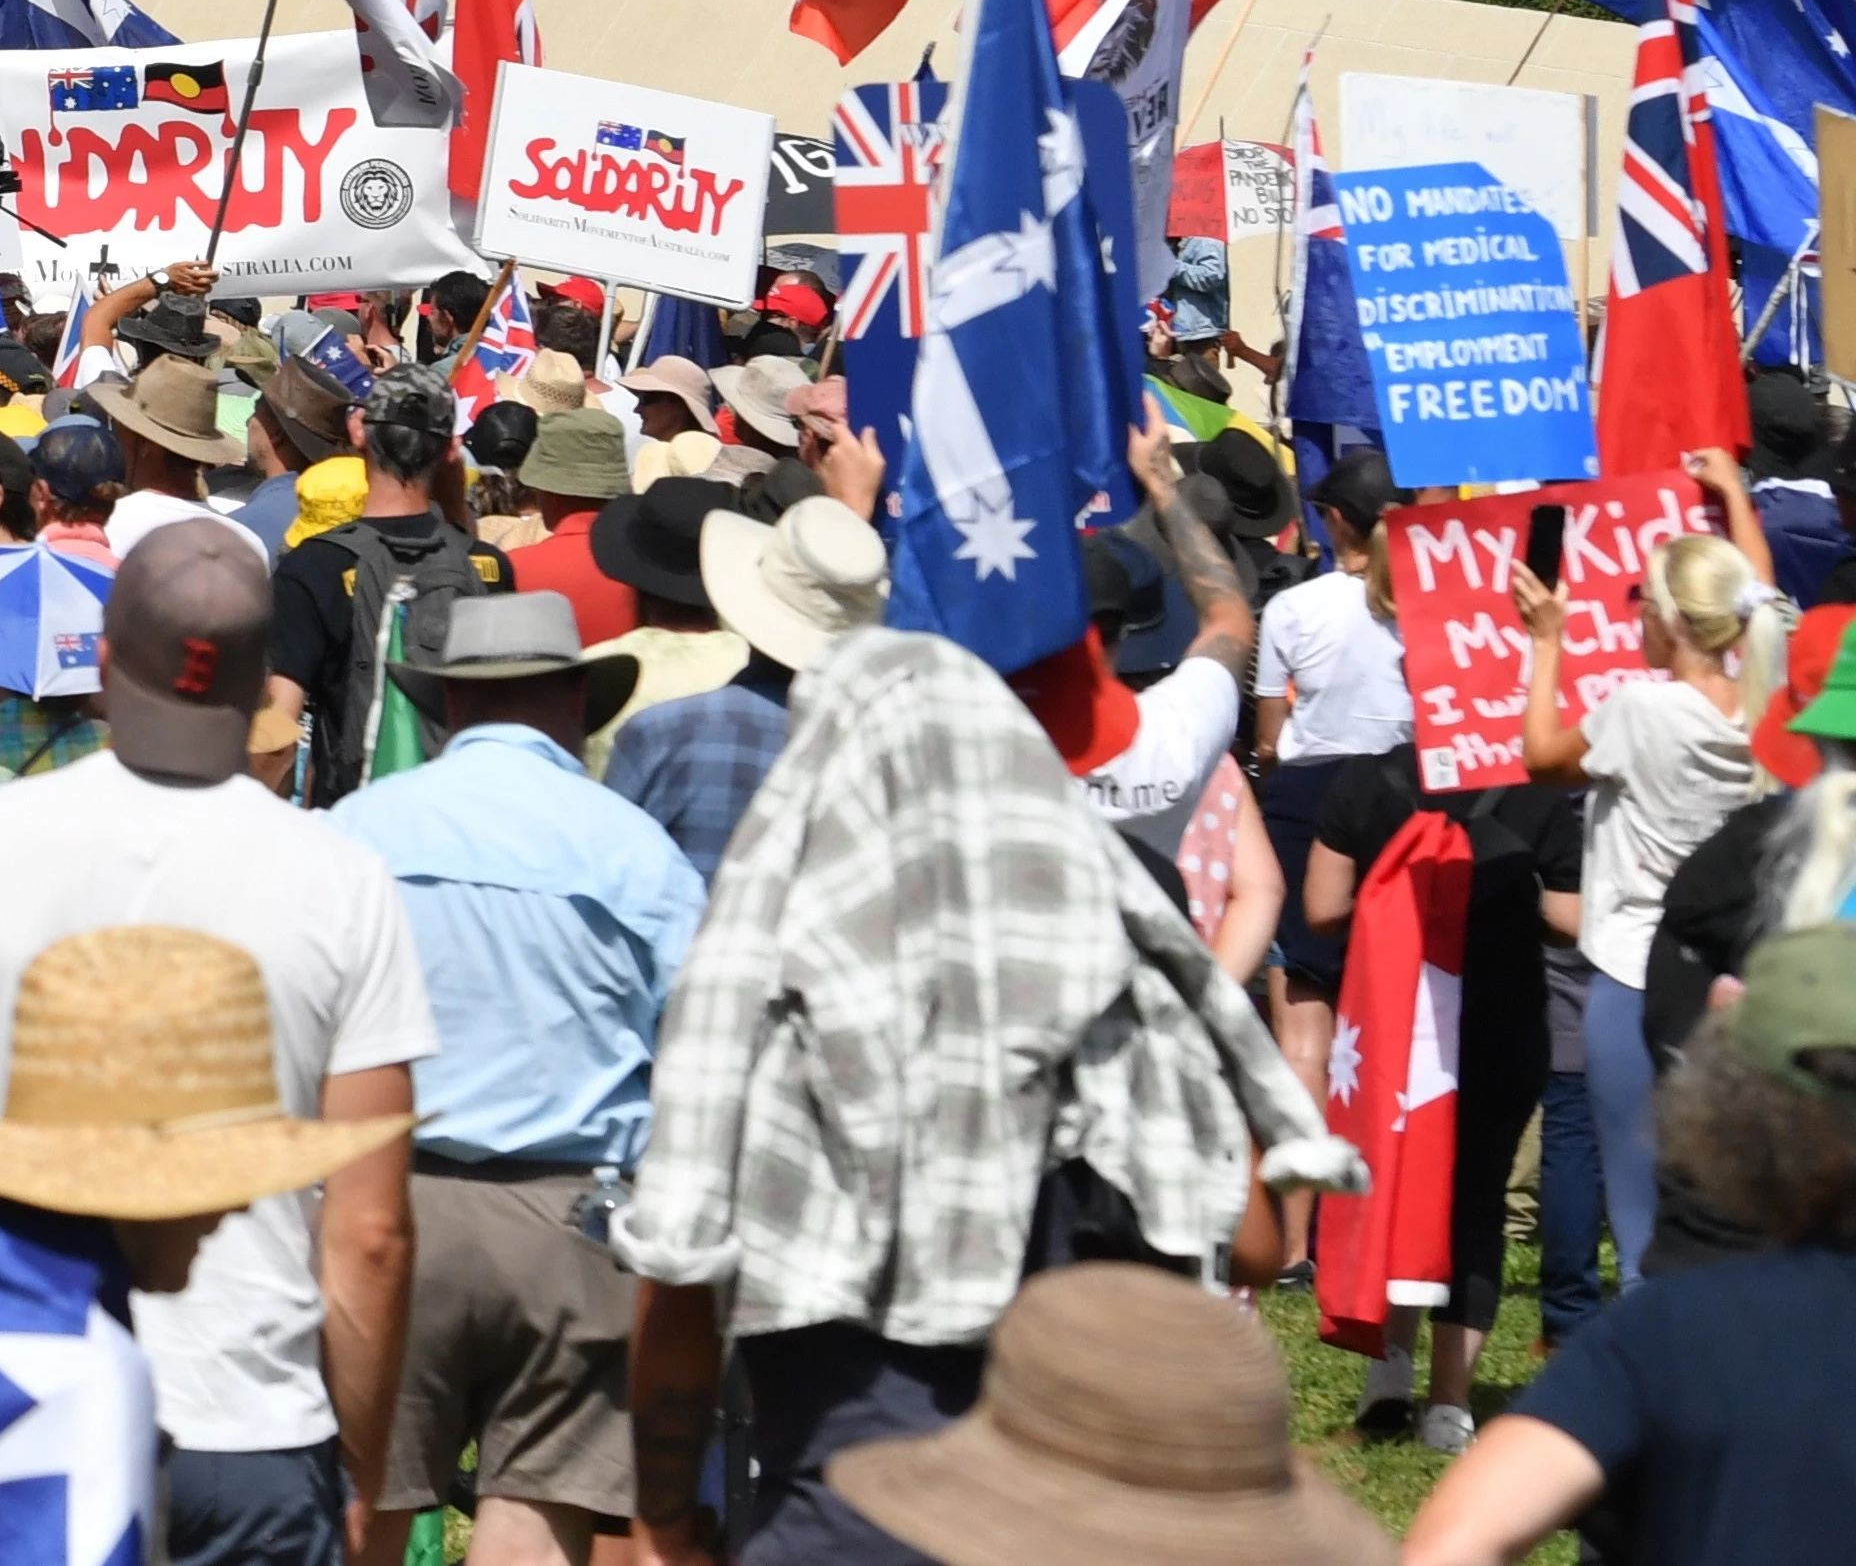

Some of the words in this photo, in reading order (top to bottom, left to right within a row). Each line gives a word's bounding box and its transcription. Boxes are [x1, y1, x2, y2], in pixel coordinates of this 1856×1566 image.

[9, 108, 357, 238] LIDARITY
[1340, 185, 1393, 226] NO
[1405, 184, 1536, 219] MANDATES
[1357, 242, 1415, 273] FOR
[1405, 519, 1517, 594] My
[172, 636, 219, 694] B
[1444, 611, 1533, 687] My
[1421, 684, 1465, 727] I
[1132, 779, 1182, 809] me
